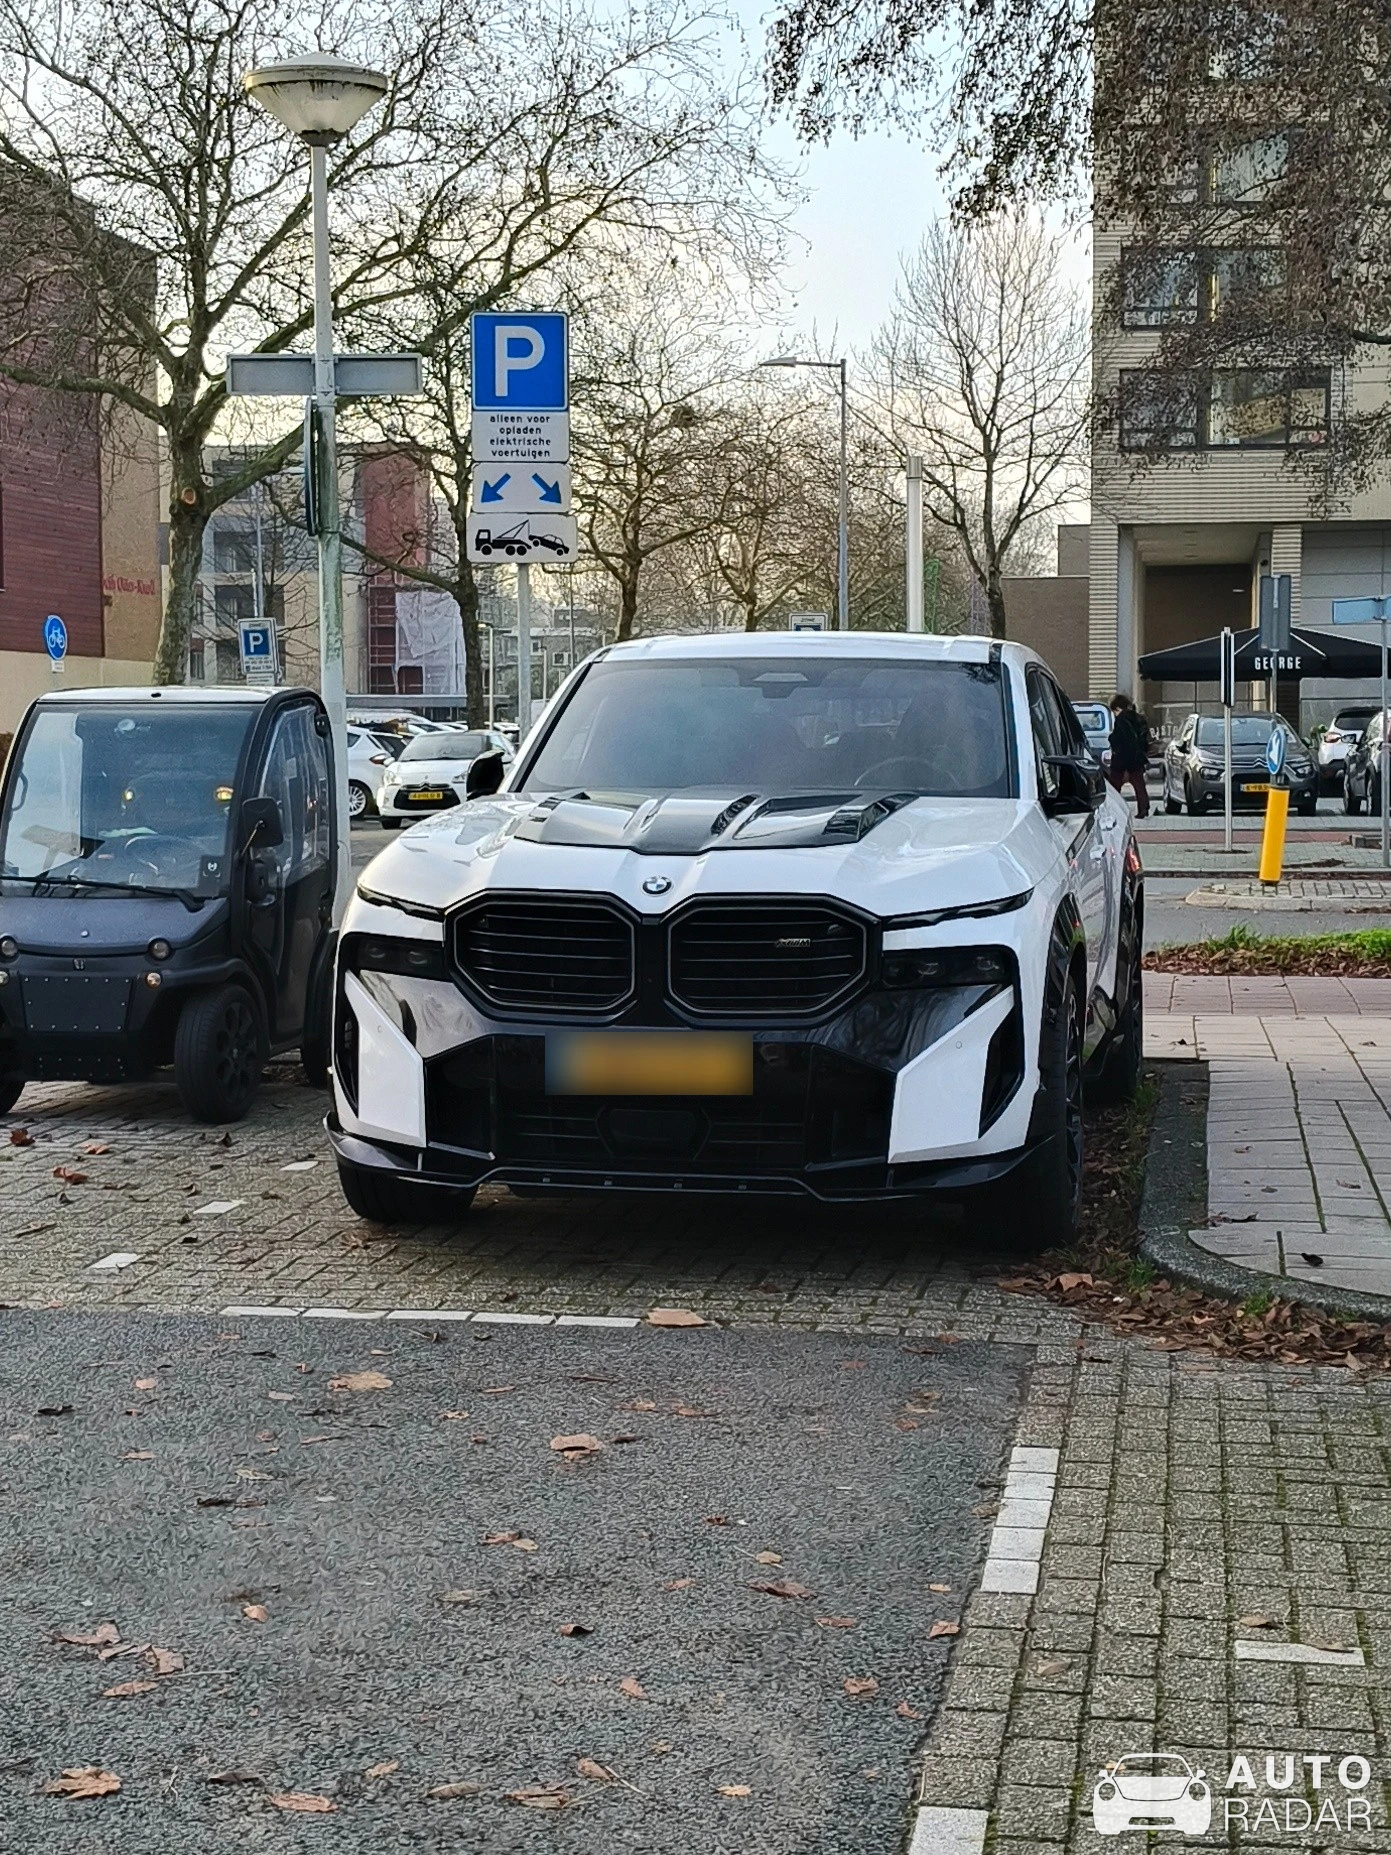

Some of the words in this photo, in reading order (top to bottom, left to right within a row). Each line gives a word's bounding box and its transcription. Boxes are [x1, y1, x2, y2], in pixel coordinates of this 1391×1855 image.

[495, 326, 545, 396] P
[489, 414, 523, 423] alleen
[526, 415, 551, 423] voor
[499, 425, 542, 435] opladen
[489, 437, 551, 446] elektrische
[491, 448, 551, 459] voertuigen
[249, 632, 264, 653] P
